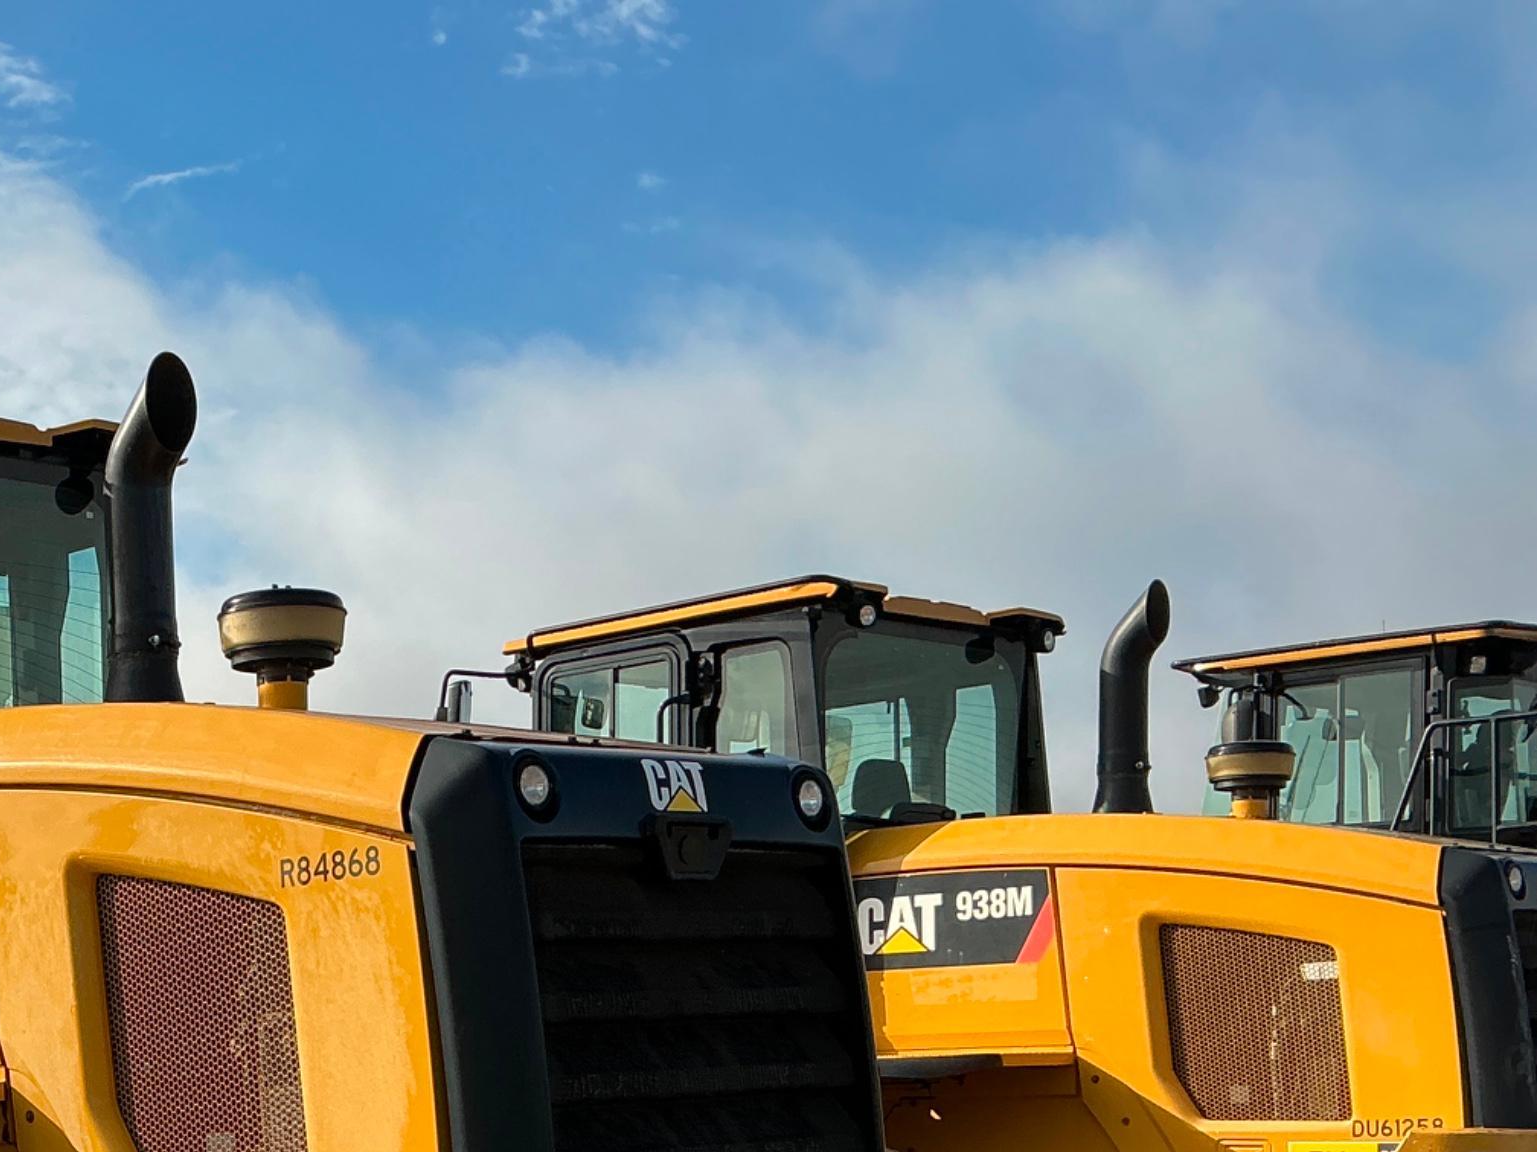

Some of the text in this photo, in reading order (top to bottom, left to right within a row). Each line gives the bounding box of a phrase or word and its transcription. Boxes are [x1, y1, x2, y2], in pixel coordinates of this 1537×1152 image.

[641, 759, 708, 812] CAT
[280, 846, 380, 888] R84868
[858, 886, 1033, 955] CAT 938M
